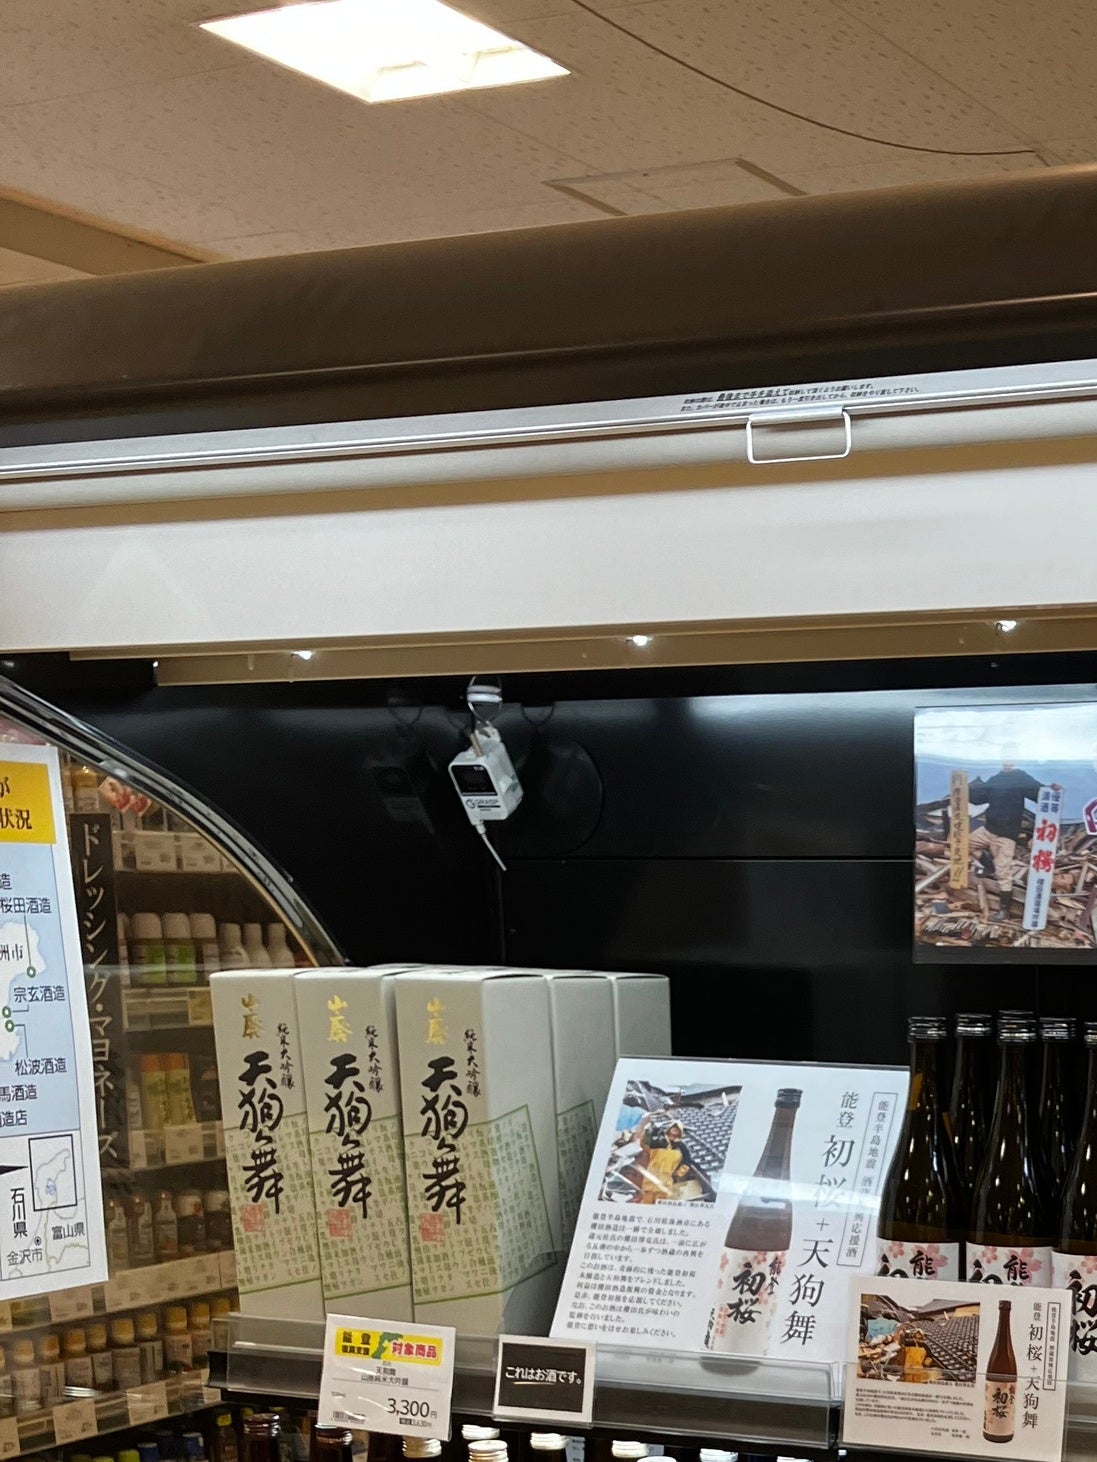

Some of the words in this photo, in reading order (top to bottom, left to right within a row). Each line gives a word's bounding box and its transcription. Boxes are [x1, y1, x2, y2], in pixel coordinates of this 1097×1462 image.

[13, 985, 66, 1003] 宗玄酒造
[15, 1057, 67, 1076] 松波酒造
[837, 1091, 859, 1129] 能登
[238, 1051, 284, 1215] 天狗舞
[324, 1053, 373, 1219] 天狗舞
[10, 1187, 28, 1239] 石川県
[51, 1221, 86, 1241] 富山県
[7, 1248, 43, 1267] 金沢市
[780, 1238, 836, 1346] 天狗舞
[1026, 1324, 1044, 1362] 初桜
[505, 1365, 582, 1385] これはお酒です。
[387, 1398, 438, 1420] 3,300円
[1022, 1376, 1041, 1429] 天狗舞
